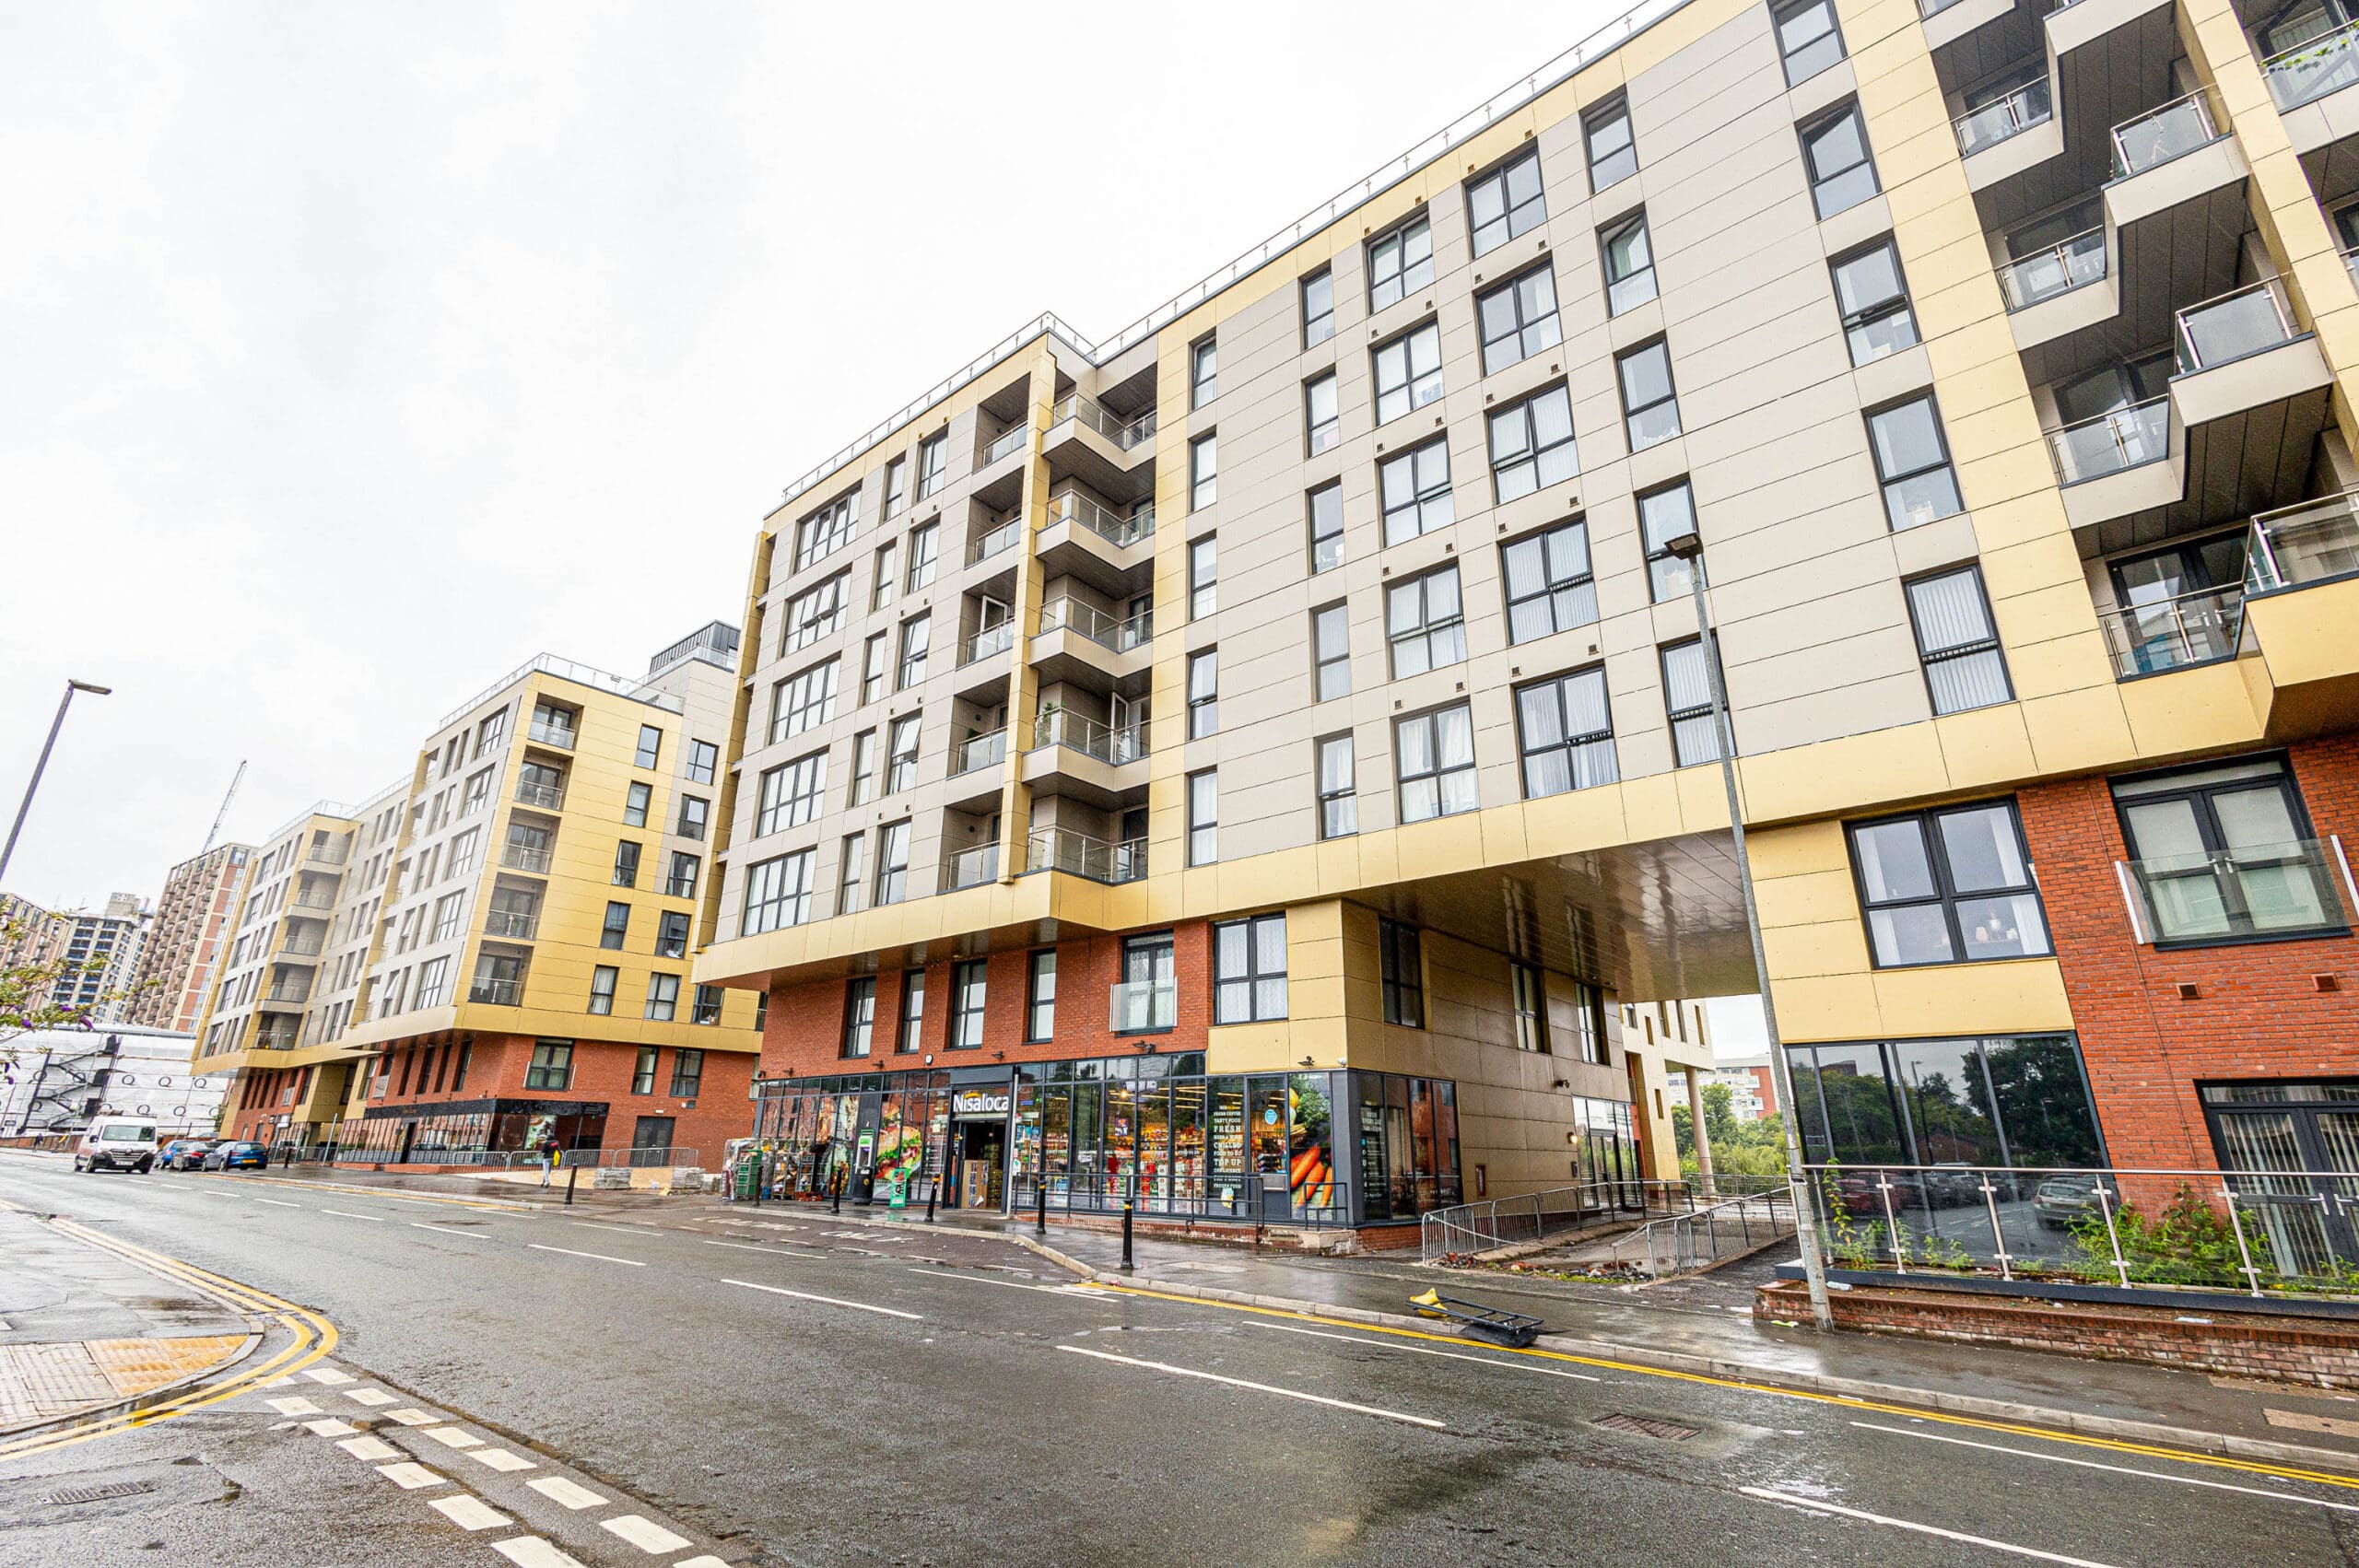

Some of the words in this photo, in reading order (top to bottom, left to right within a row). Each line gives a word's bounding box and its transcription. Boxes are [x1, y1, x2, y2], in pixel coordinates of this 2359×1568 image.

[122, 1074, 135, 1085] Q
[158, 1076, 172, 1088] Q
[194, 1078, 207, 1089] Q
